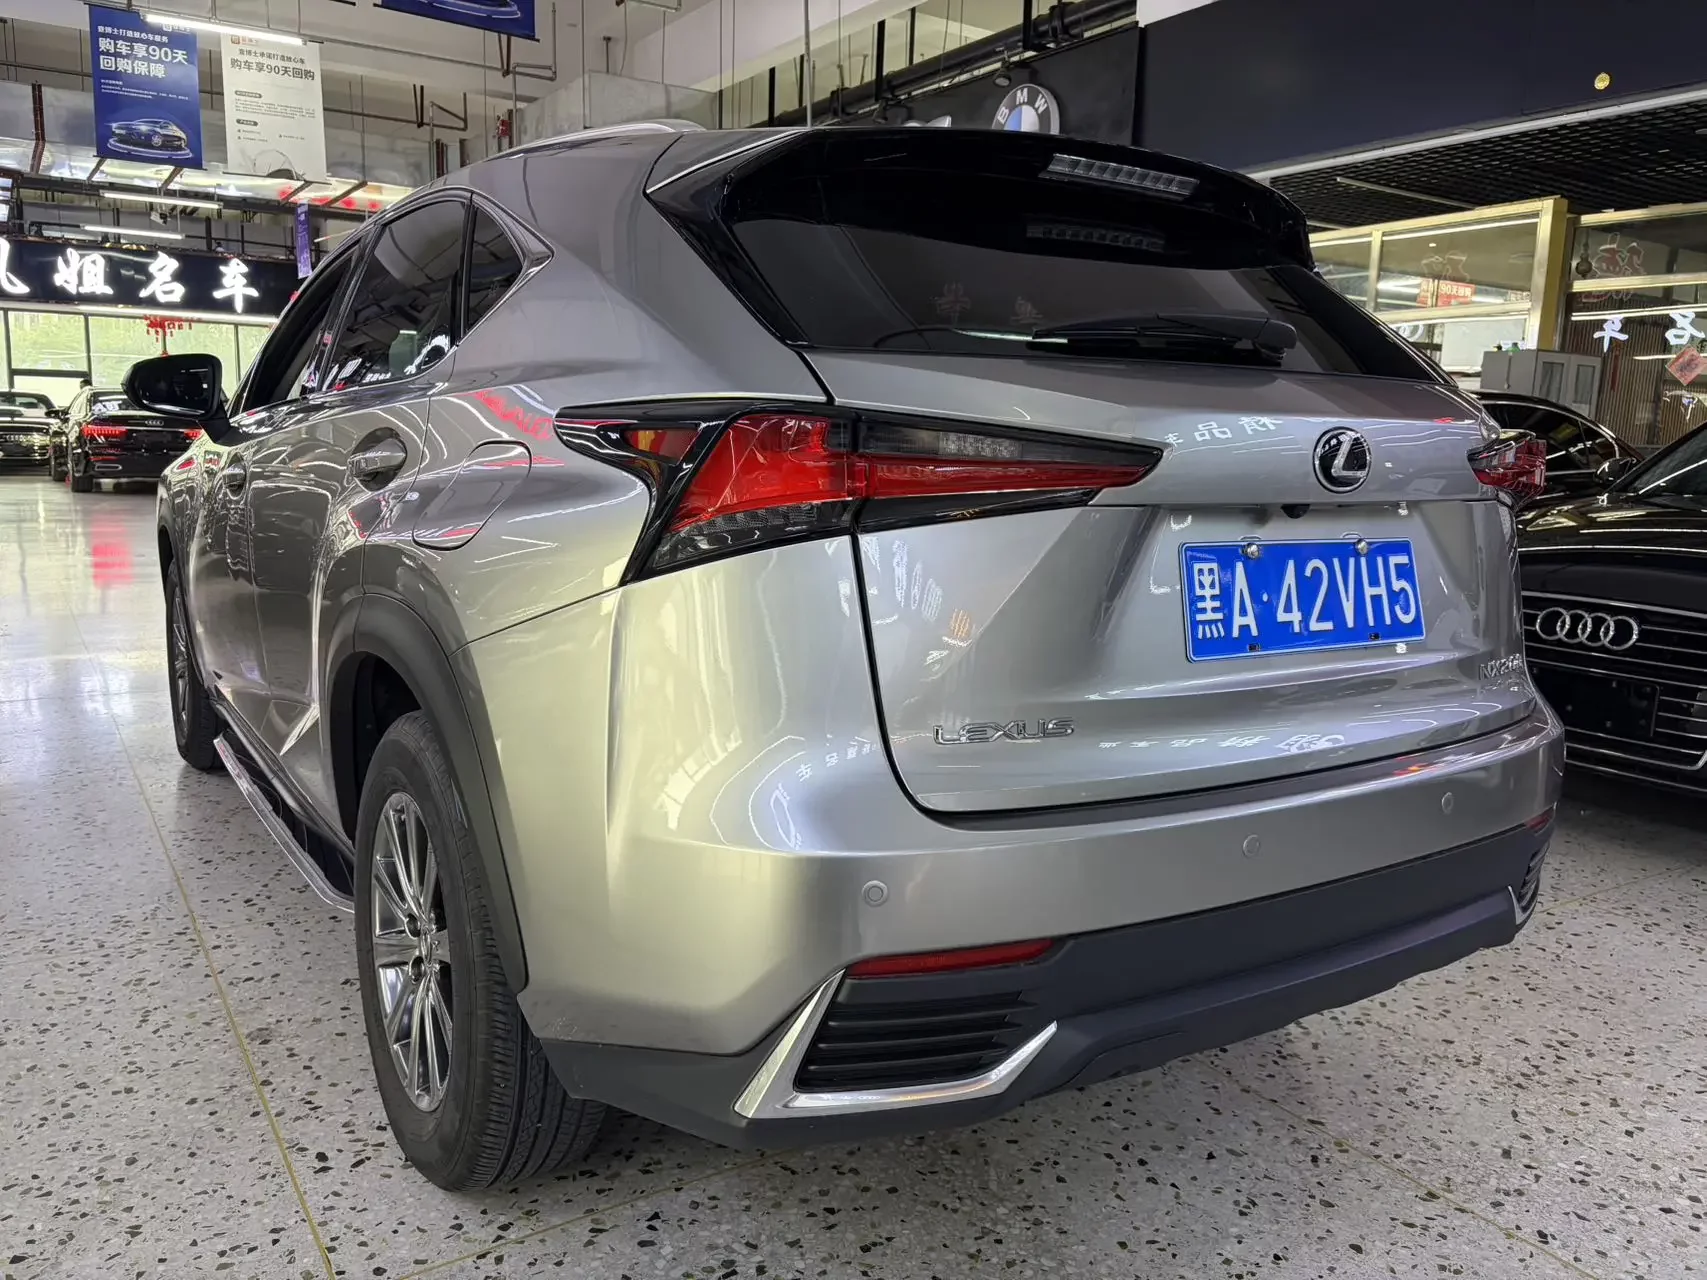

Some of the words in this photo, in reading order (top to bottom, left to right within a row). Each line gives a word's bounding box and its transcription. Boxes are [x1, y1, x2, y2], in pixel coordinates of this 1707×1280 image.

[98, 37, 188, 65] 购车享90天
[100, 55, 167, 78] 回购保障
[230, 57, 315, 81] 购车享90天回购
[997, 88, 1047, 125] BMW
[933, 716, 1075, 745] LEXUS
